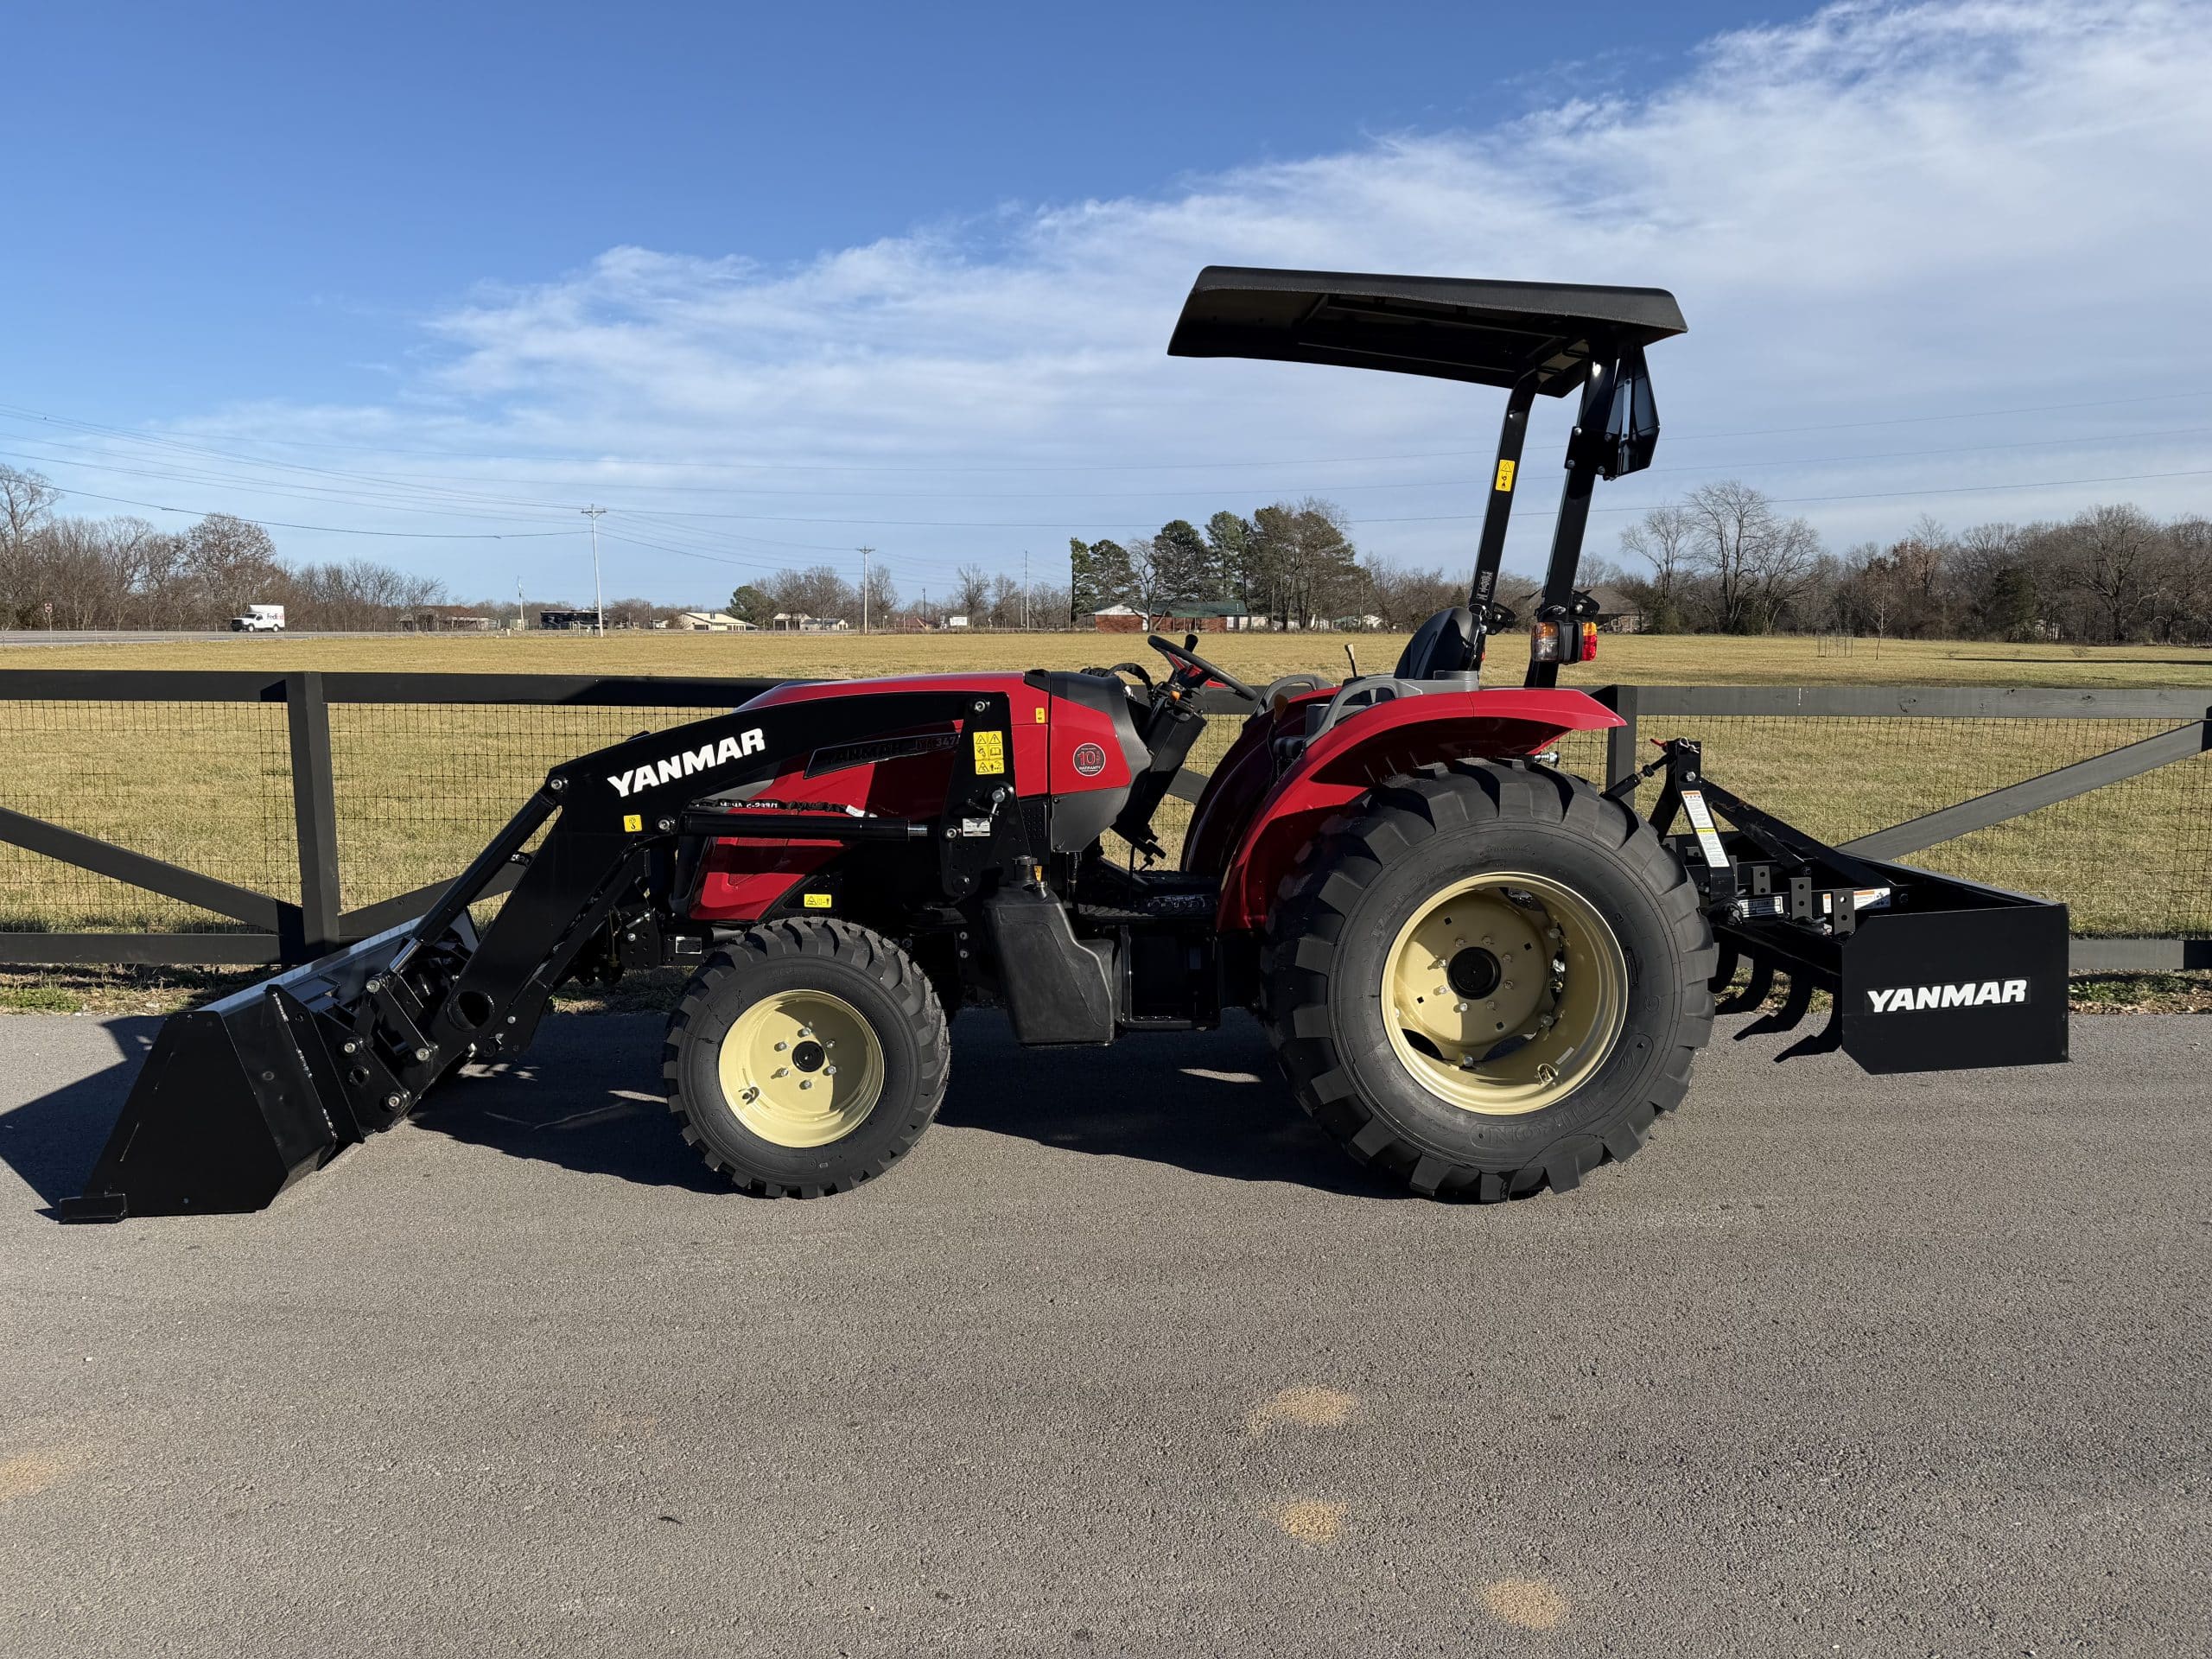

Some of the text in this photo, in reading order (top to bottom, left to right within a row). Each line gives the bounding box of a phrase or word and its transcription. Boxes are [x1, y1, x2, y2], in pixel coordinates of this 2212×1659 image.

[607, 728, 766, 798] YANMAR
[1077, 751, 1096, 766] 10
[1867, 979, 2027, 1013] YANMAR
